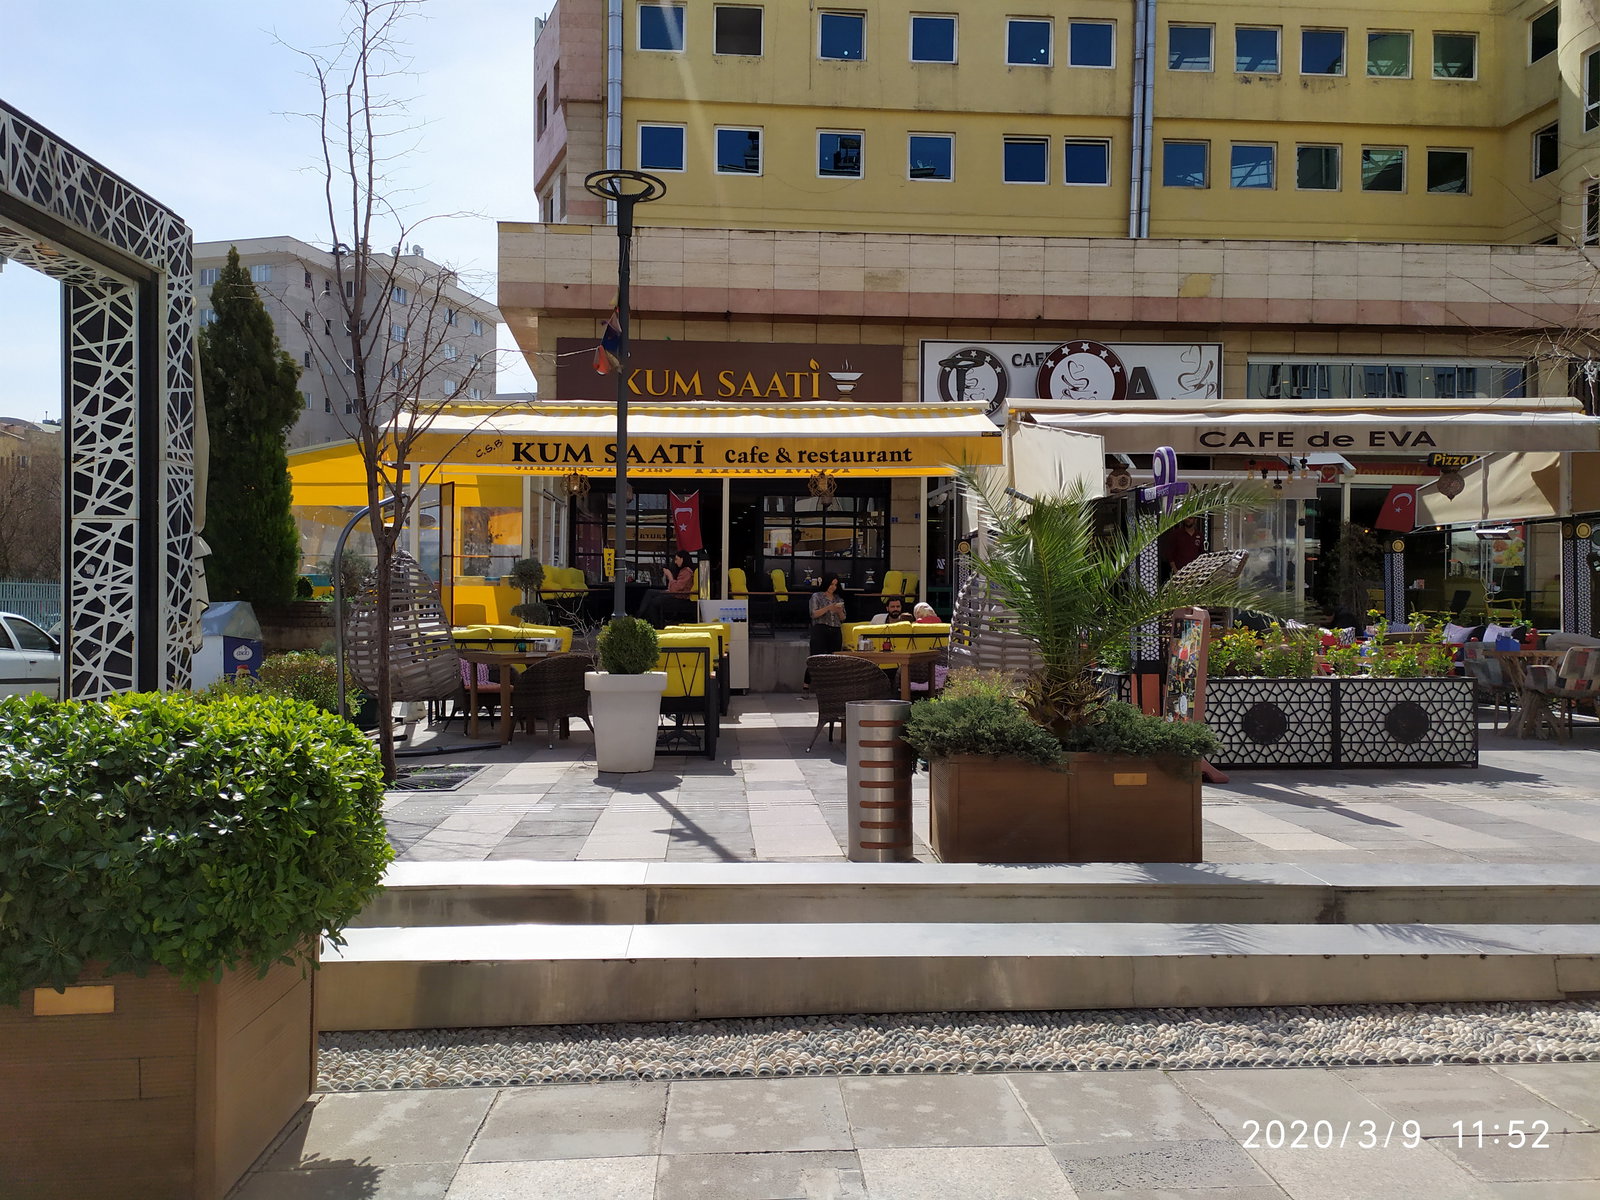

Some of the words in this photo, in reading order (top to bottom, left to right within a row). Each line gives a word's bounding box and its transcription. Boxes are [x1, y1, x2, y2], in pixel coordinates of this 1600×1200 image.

[717, 358, 821, 399] SAATİ
[1199, 431, 1294, 448] CAFE
[1307, 431, 1355, 448] de
[1368, 430, 1438, 447] EVA
[511, 442, 594, 463] KUM
[604, 440, 704, 464] SAATİ
[724, 446, 770, 464] cafe
[775, 447, 793, 464] &
[797, 447, 913, 463] restaurant
[1432, 453, 1468, 466] Pizza
